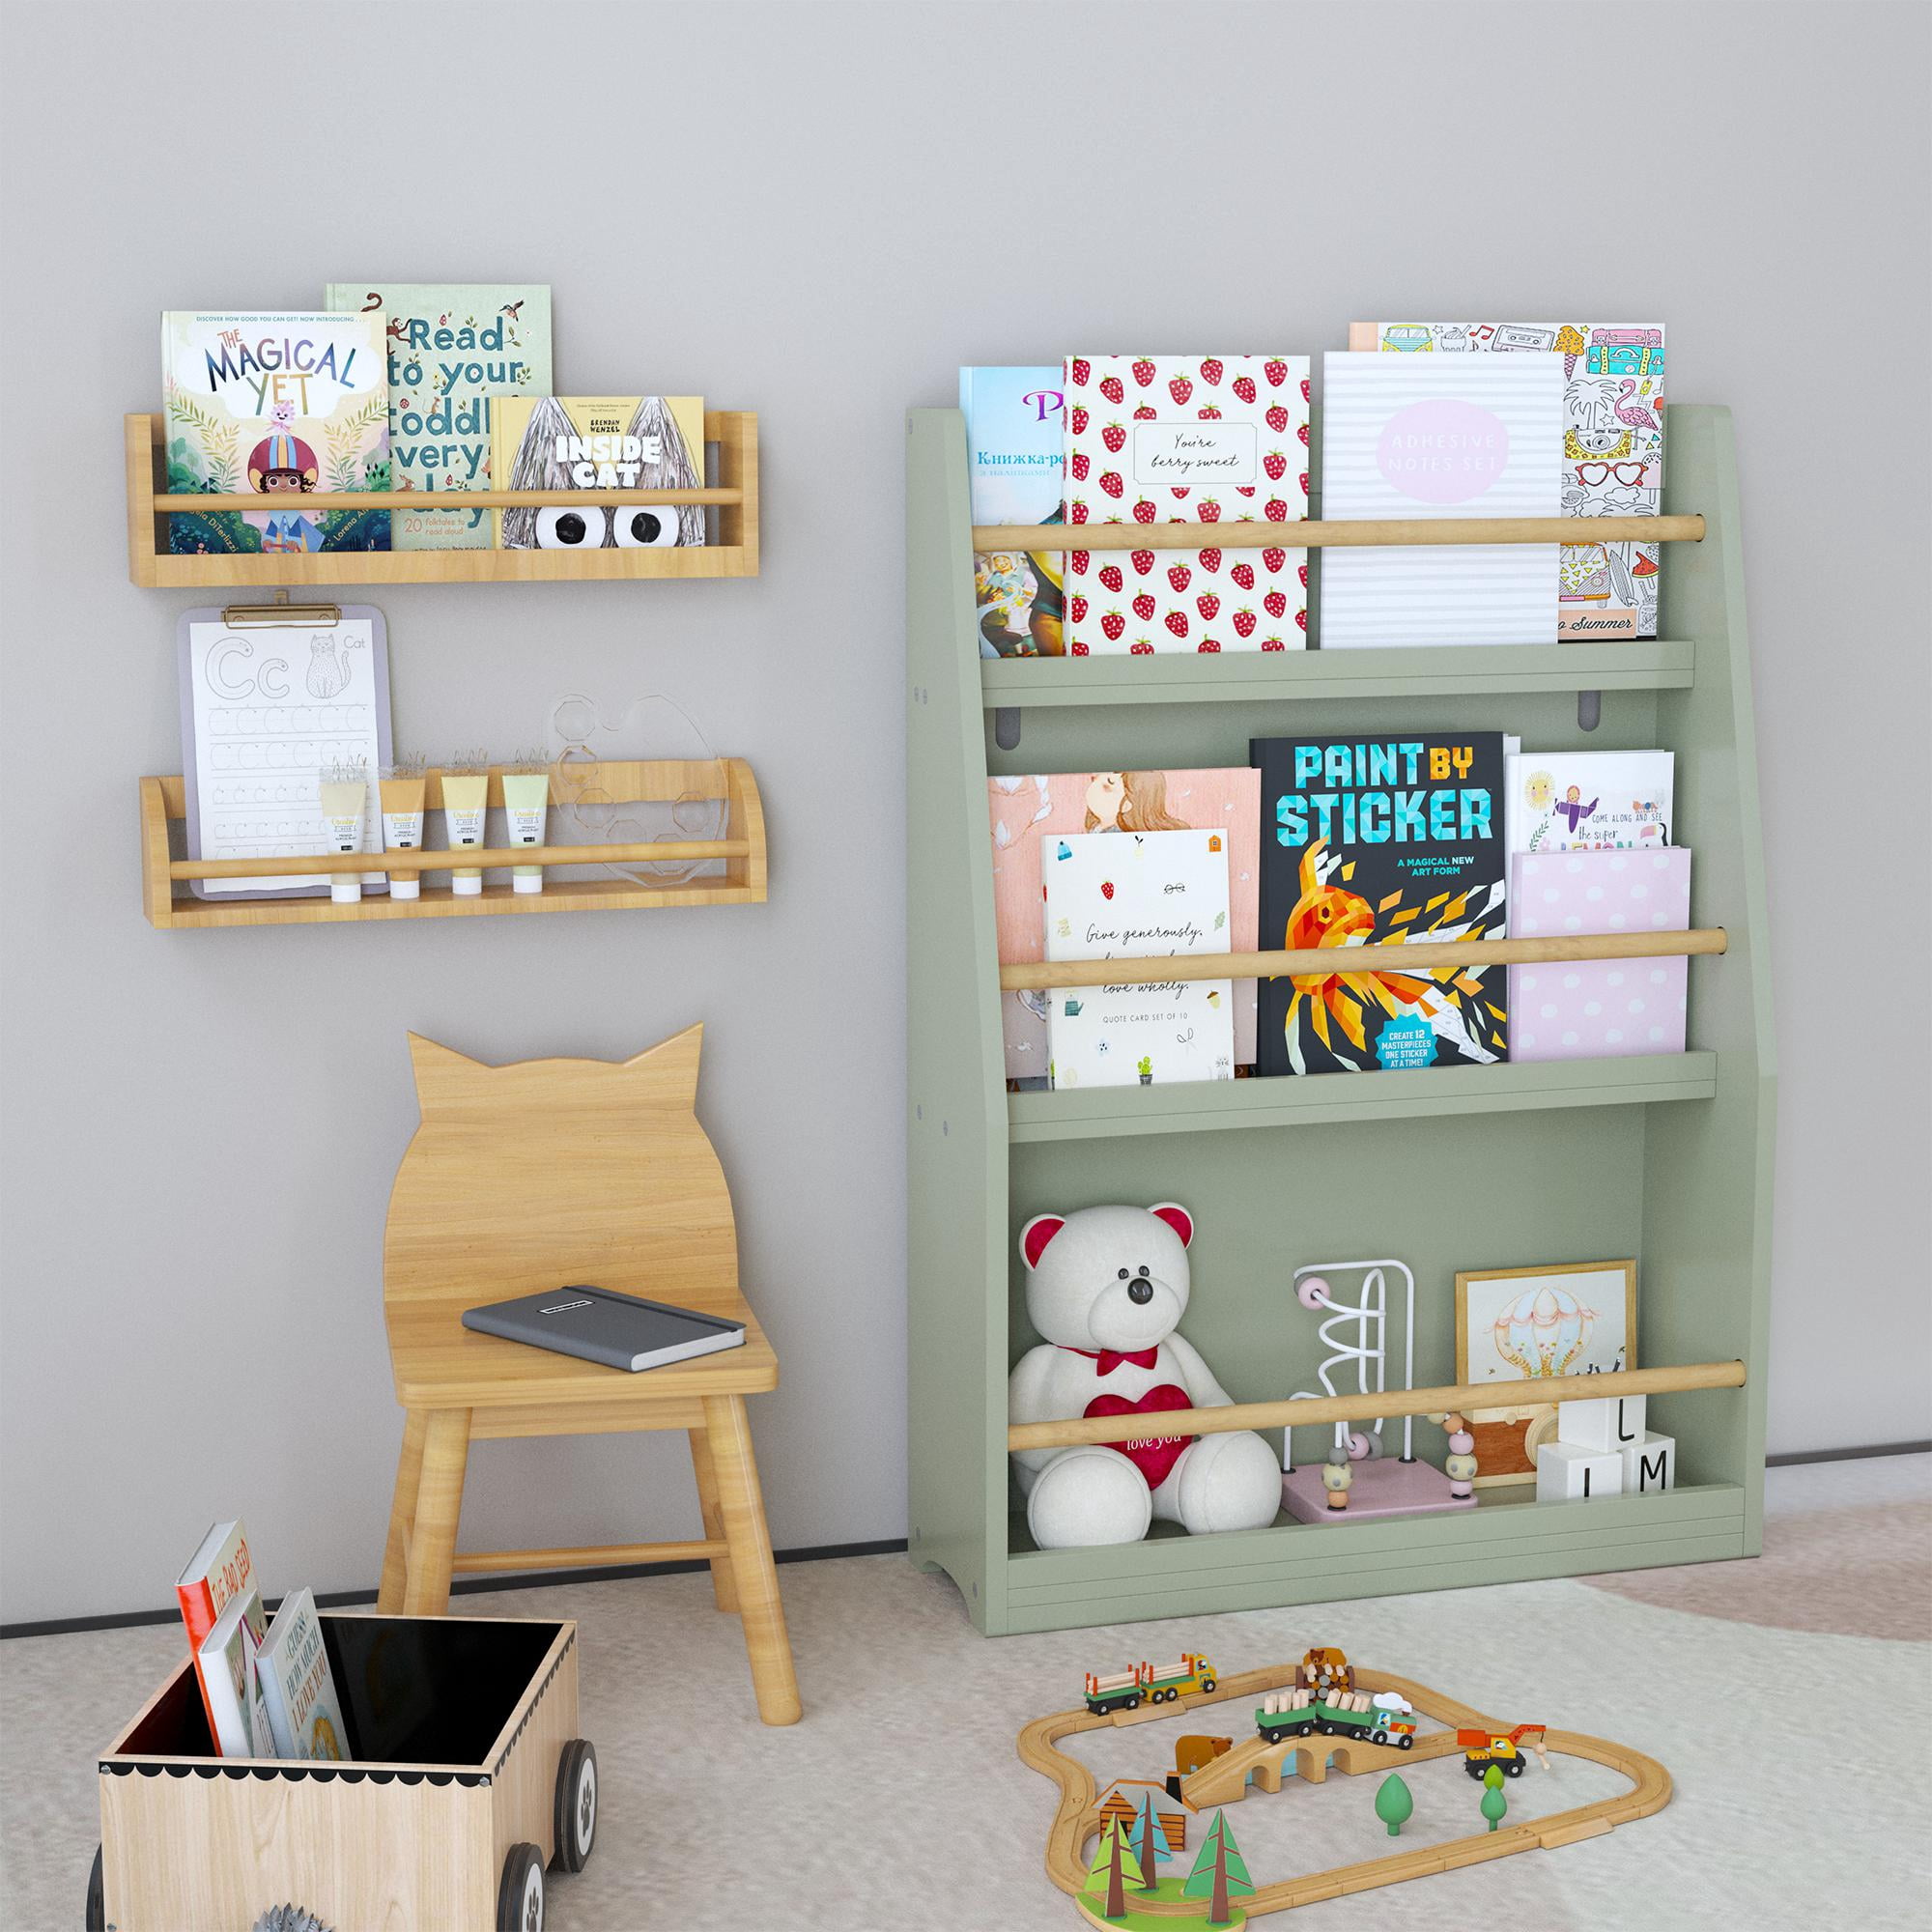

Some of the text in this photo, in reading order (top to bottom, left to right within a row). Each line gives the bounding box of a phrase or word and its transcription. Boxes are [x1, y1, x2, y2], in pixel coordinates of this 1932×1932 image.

[217, 328, 243, 349] THE
[410, 316, 503, 351] Read
[205, 338, 356, 392] MAGICAL
[387, 355, 524, 396] to your
[246, 373, 313, 416] YET
[556, 434, 661, 465] INSIDE
[1174, 432, 1217, 449] You're
[1391, 434, 1496, 449] ADHESIVE
[388, 444, 483, 480] very
[1151, 454, 1240, 474] berry sweet
[1388, 456, 1496, 471] NOTES SET
[572, 461, 640, 488] CAT
[333, 517, 357, 541] Lorena
[404, 518, 423, 533] 20
[425, 518, 455, 526] folktales
[1569, 616, 1633, 631] Summer
[344, 635, 366, 649] Cat
[1295, 742, 1473, 789] PAINT BY
[1276, 788, 1493, 847] STICKER
[1592, 812, 1662, 824] COME ALONG AND SEE
[1579, 826, 1619, 842] the super
[1397, 856, 1475, 867] A MAGICAL NEW
[1412, 867, 1461, 876] ART FORM
[1086, 921, 1203, 946] Give generously.
[1102, 981, 1189, 1000] love wholly.
[1103, 1015, 1126, 1023] QUOTE
[1130, 1014, 1149, 1022] CARD
[1152, 1013, 1164, 1021] SET
[1166, 1012, 1176, 1021] OF
[1389, 1029, 1425, 1040] CREATE 12
[1382, 1040, 1431, 1050] MASTERPIECES
[1385, 1049, 1428, 1059] ONE STICKER
[1391, 1060, 1399, 1068] AT
[1405, 1058, 1423, 1067] TIME!
[1127, 1437, 1153, 1450] love
[1640, 1450, 1667, 1492] M
[212, 1577, 227, 1614] THE
[222, 1562, 239, 1597] BAD
[287, 1611, 307, 1659] GUESS
[286, 1625, 319, 1701] HOW MUCH
[292, 1649, 327, 1732] I LOVE YOU
